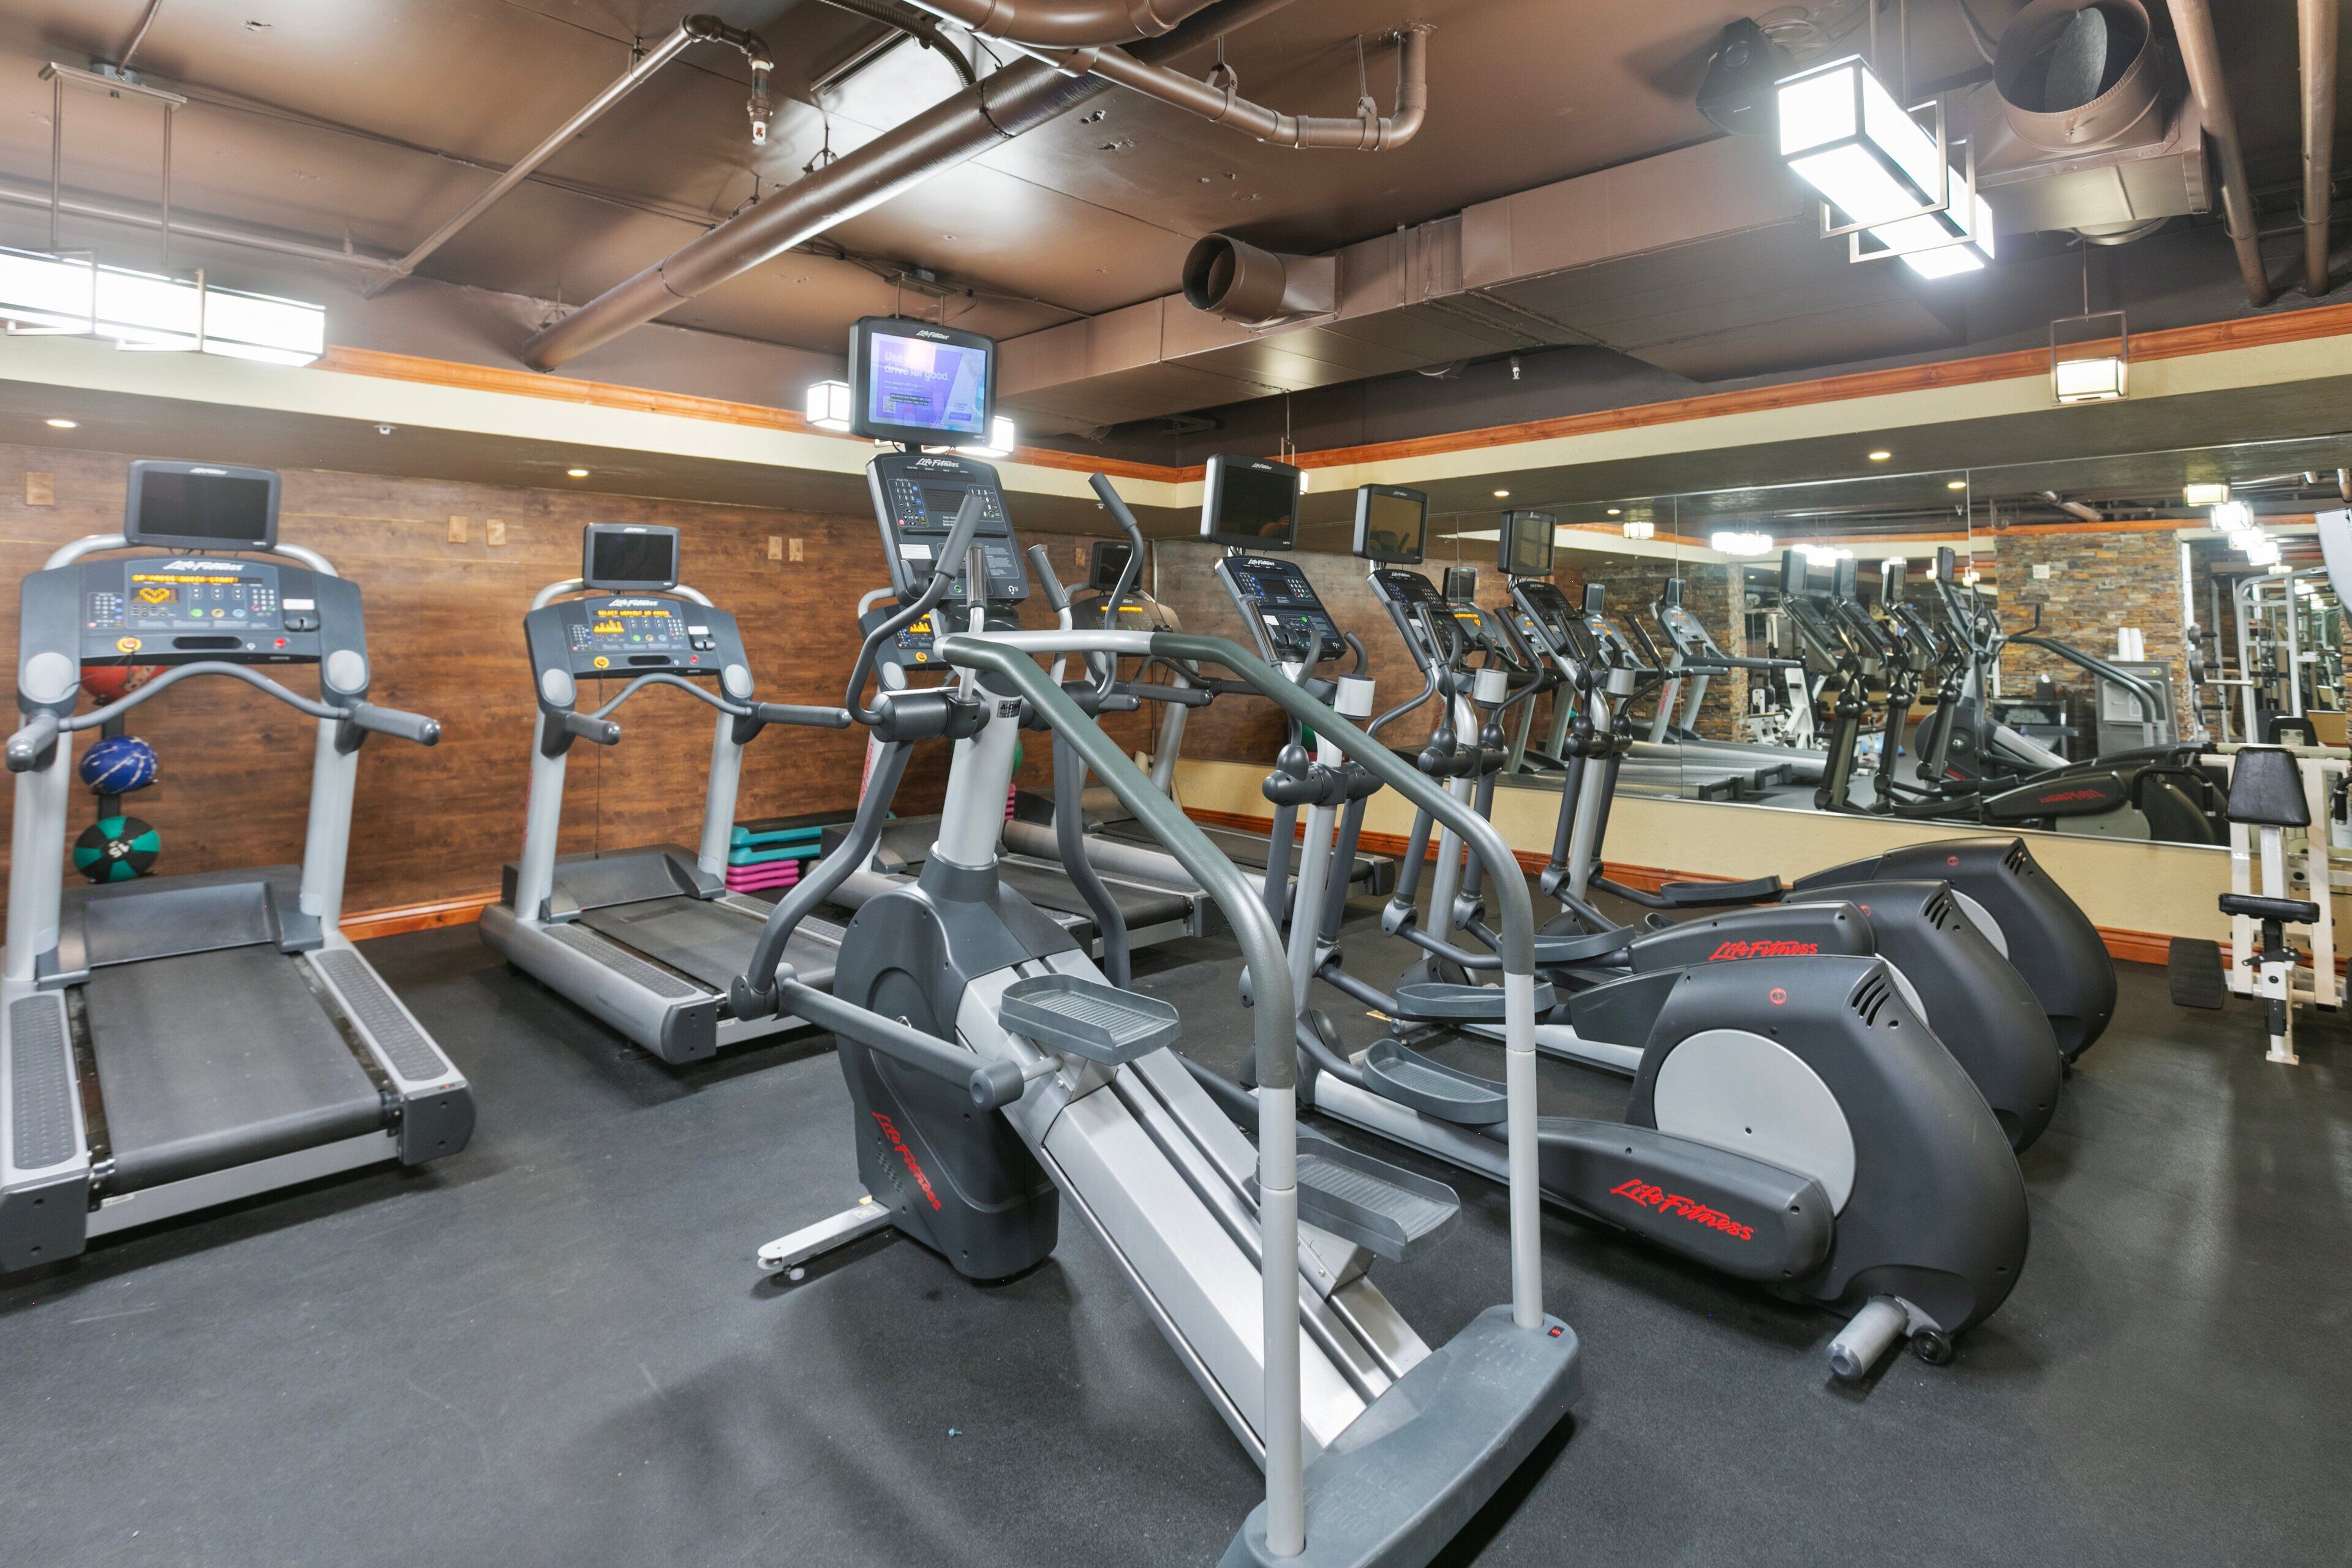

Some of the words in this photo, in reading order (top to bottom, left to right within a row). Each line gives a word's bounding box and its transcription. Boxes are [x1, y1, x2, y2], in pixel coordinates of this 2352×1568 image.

[884, 351, 903, 363] Use
[924, 371, 950, 382] good.
[915, 458, 933, 467] Life
[931, 459, 959, 468] Fitness
[1708, 941, 1749, 961] Life
[1747, 940, 1819, 958] Fitness
[872, 1110, 901, 1145] Life
[894, 1143, 941, 1211] Fitness
[1610, 1178, 1664, 1208] Life
[1657, 1194, 1754, 1240] Fitness
